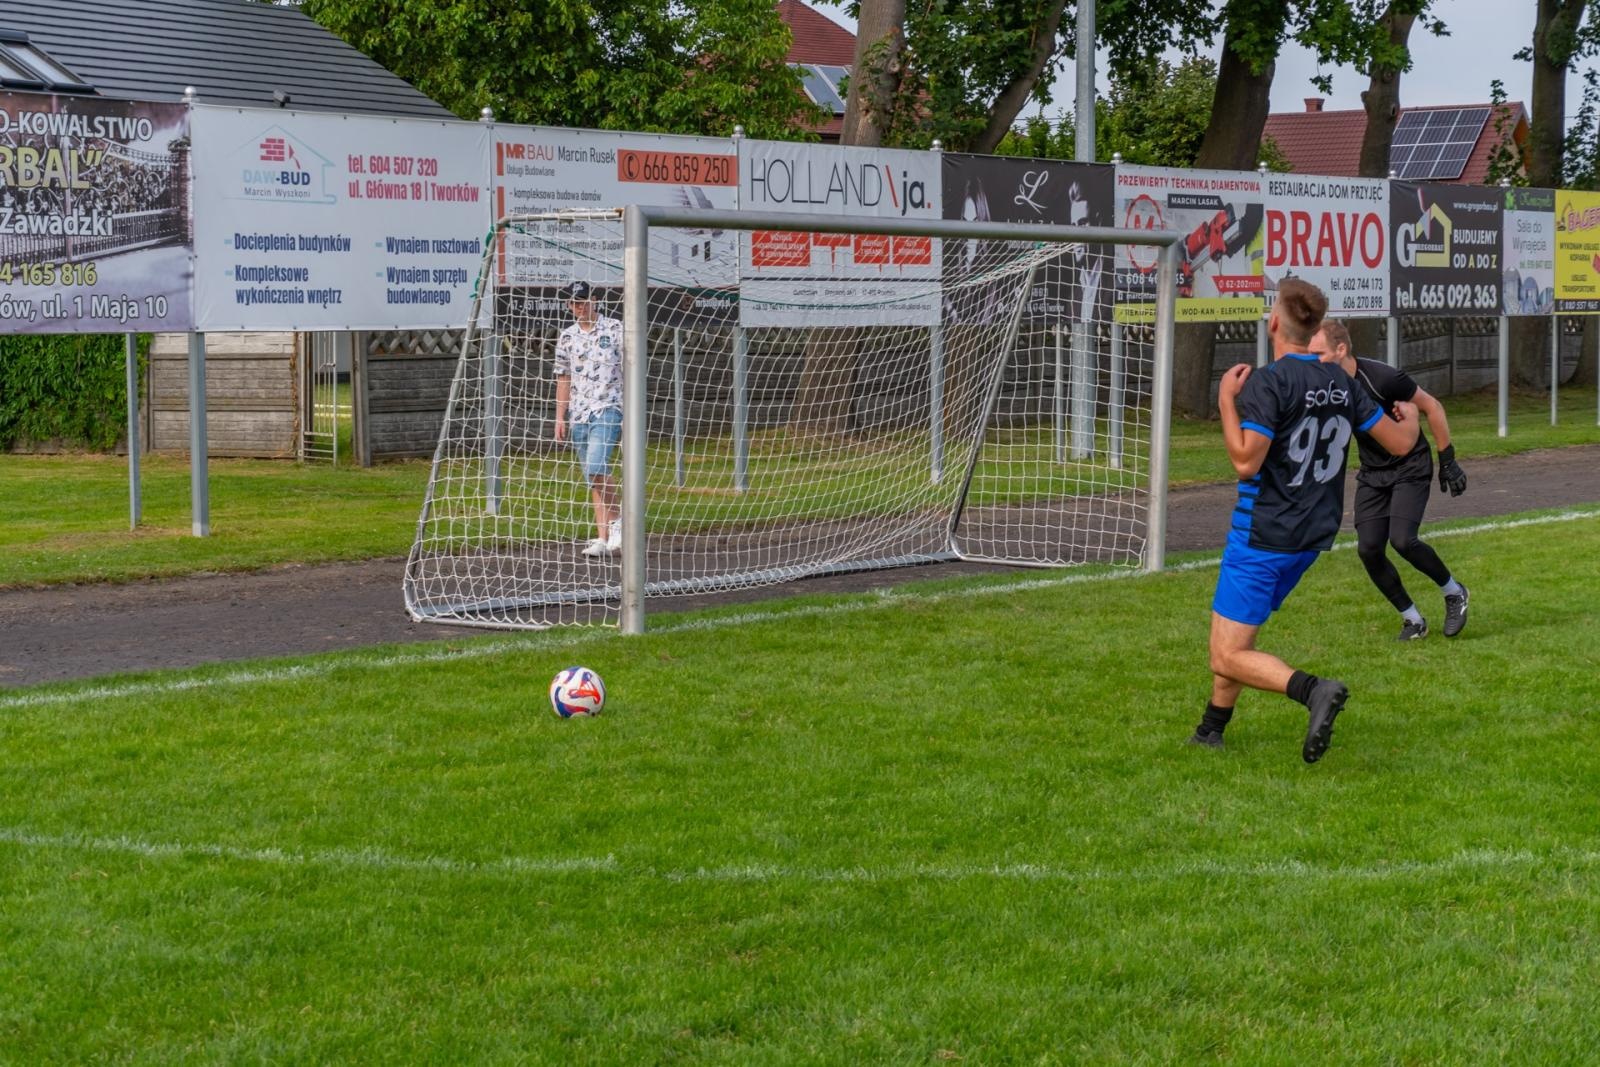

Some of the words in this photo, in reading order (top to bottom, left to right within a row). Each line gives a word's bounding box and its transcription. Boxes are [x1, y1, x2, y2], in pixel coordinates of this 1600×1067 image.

[506, 143, 525, 160] MR
[527, 144, 554, 161] BAU
[558, 145, 588, 162] Marcin
[589, 147, 616, 164] Rusek
[348, 154, 366, 174] tel.
[369, 156, 391, 175] 604
[393, 157, 413, 176] 507
[417, 158, 438, 177] 320
[525, 165, 555, 177] Budowlane
[643, 154, 669, 181] 666
[674, 155, 699, 182] 859
[704, 158, 729, 184] 250
[243, 170, 311, 186] DAW-BUD
[1118, 175, 1169, 189] PRZEWIERTY
[1171, 178, 1210, 192] TECHNIKĄ
[244, 187, 272, 197] Marcin
[275, 188, 311, 199] Wyszkoni
[348, 180, 363, 198] ul.
[366, 180, 407, 200] Główna
[410, 182, 422, 201] 18
[431, 183, 479, 202] Tworków
[514, 188, 556, 201] kompleksowa
[557, 189, 580, 201] budowa
[581, 189, 602, 201] domów
[1269, 181, 1327, 198] RESTAURACJA
[1329, 184, 1349, 199] DOM
[1351, 182, 1383, 204] PRZYJĘĆ
[1171, 197, 1197, 206] MARCIN
[234, 232, 296, 252] Docieplenia
[299, 234, 351, 253] budynków
[386, 236, 430, 255] Wynajem
[432, 237, 480, 254] rusztowań
[1266, 210, 1384, 269] BRAVO
[1453, 229, 1498, 245] BUDUJEMY
[1453, 253, 1467, 268] OD
[1468, 254, 1475, 268] A
[1477, 254, 1490, 269] DO
[1491, 254, 1497, 269] Z
[0, 262, 13, 285] 4
[20, 262, 55, 286] 165
[61, 262, 97, 286] 816
[235, 264, 309, 284] Kompleksowe
[386, 266, 430, 284] Wynajem
[432, 268, 467, 287] sprzętu
[1126, 272, 1145, 285] 608
[1331, 278, 1342, 291] tel.
[1343, 279, 1355, 291] 602
[1357, 279, 1369, 291] 744
[1371, 278, 1383, 291] 173
[236, 286, 304, 305] wykończenia
[307, 288, 342, 309] wnętrz
[387, 288, 451, 305] budowlanego
[1343, 297, 1355, 309] 606
[1357, 297, 1369, 309] 270
[1370, 296, 1383, 309] 898
[1396, 282, 1417, 309] tel.
[1420, 284, 1445, 309] 665
[1447, 284, 1471, 309] 092
[1474, 284, 1497, 308] 363
[42, 294, 68, 318] ul.
[73, 296, 83, 318] 1
[91, 295, 139, 323] Maja
[146, 296, 168, 318] 10
[1182, 307, 1215, 315] WOD-KAN
[1220, 307, 1259, 315] ELEKTRYKA
[1286, 413, 1352, 487] 93
